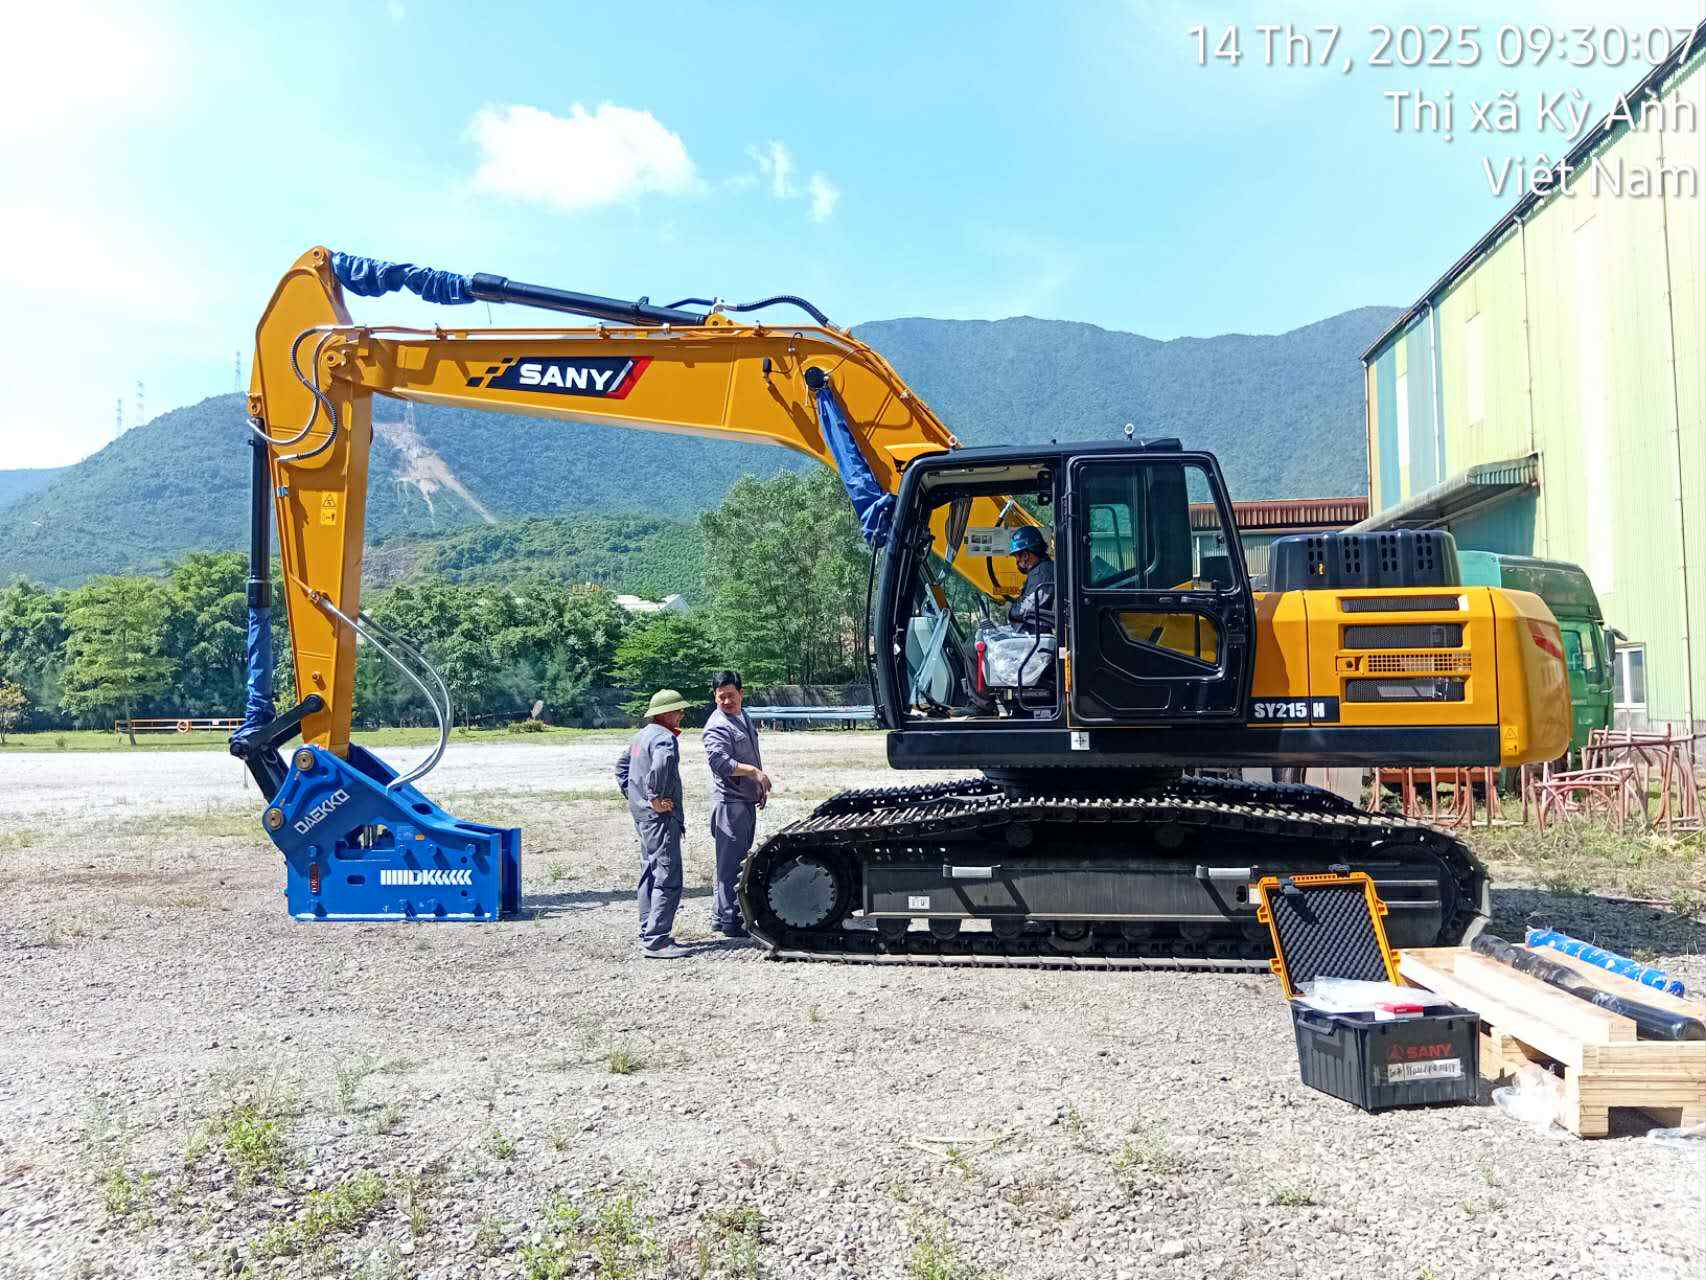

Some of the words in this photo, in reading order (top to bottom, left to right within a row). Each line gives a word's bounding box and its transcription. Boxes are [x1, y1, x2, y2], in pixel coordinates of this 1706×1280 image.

[519, 363, 613, 390] SANY
[294, 788, 350, 835] DAEKKO
[1407, 1041, 1453, 1059] SANY
